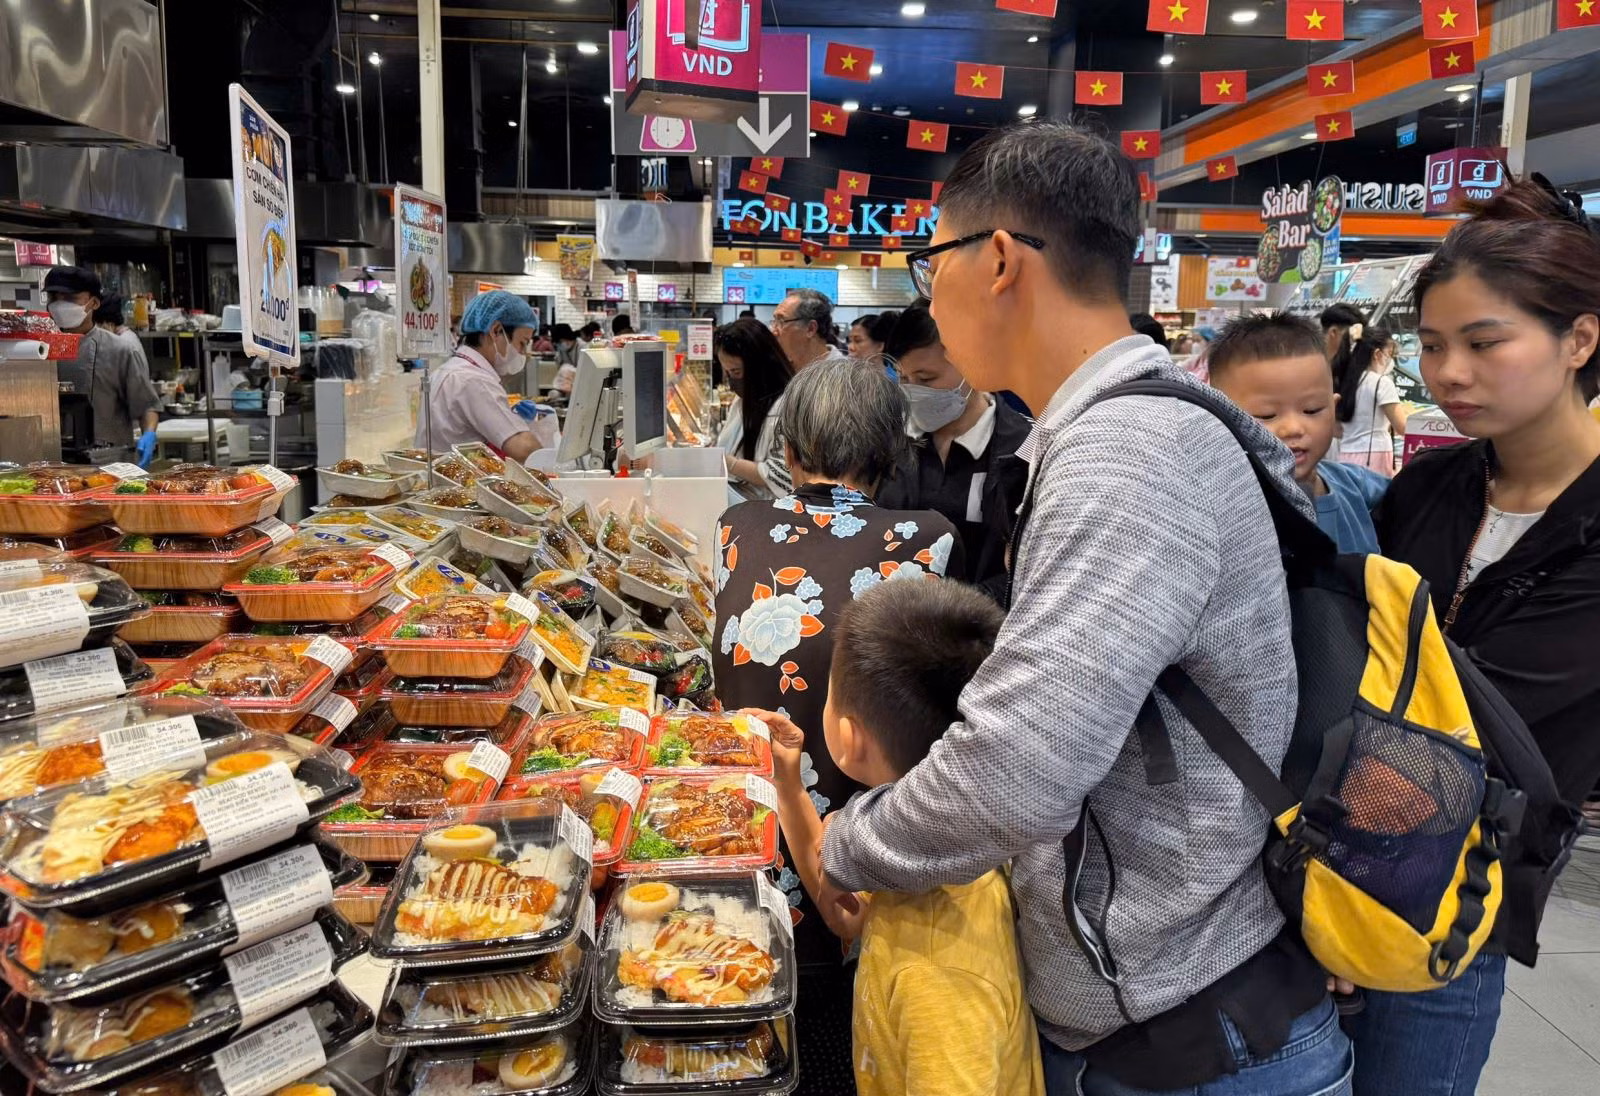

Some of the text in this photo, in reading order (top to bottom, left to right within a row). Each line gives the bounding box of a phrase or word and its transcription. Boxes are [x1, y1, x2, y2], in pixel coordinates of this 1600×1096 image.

[682, 52, 732, 76] VND
[1261, 181, 1309, 219] Salad
[1432, 192, 1447, 205] VND
[1466, 189, 1492, 199] VND
[1277, 219, 1311, 248] Bar
[606, 286, 623, 299] 35
[658, 287, 675, 301] 34
[728, 288, 745, 303] 33
[283, 933, 309, 947] 34.300
